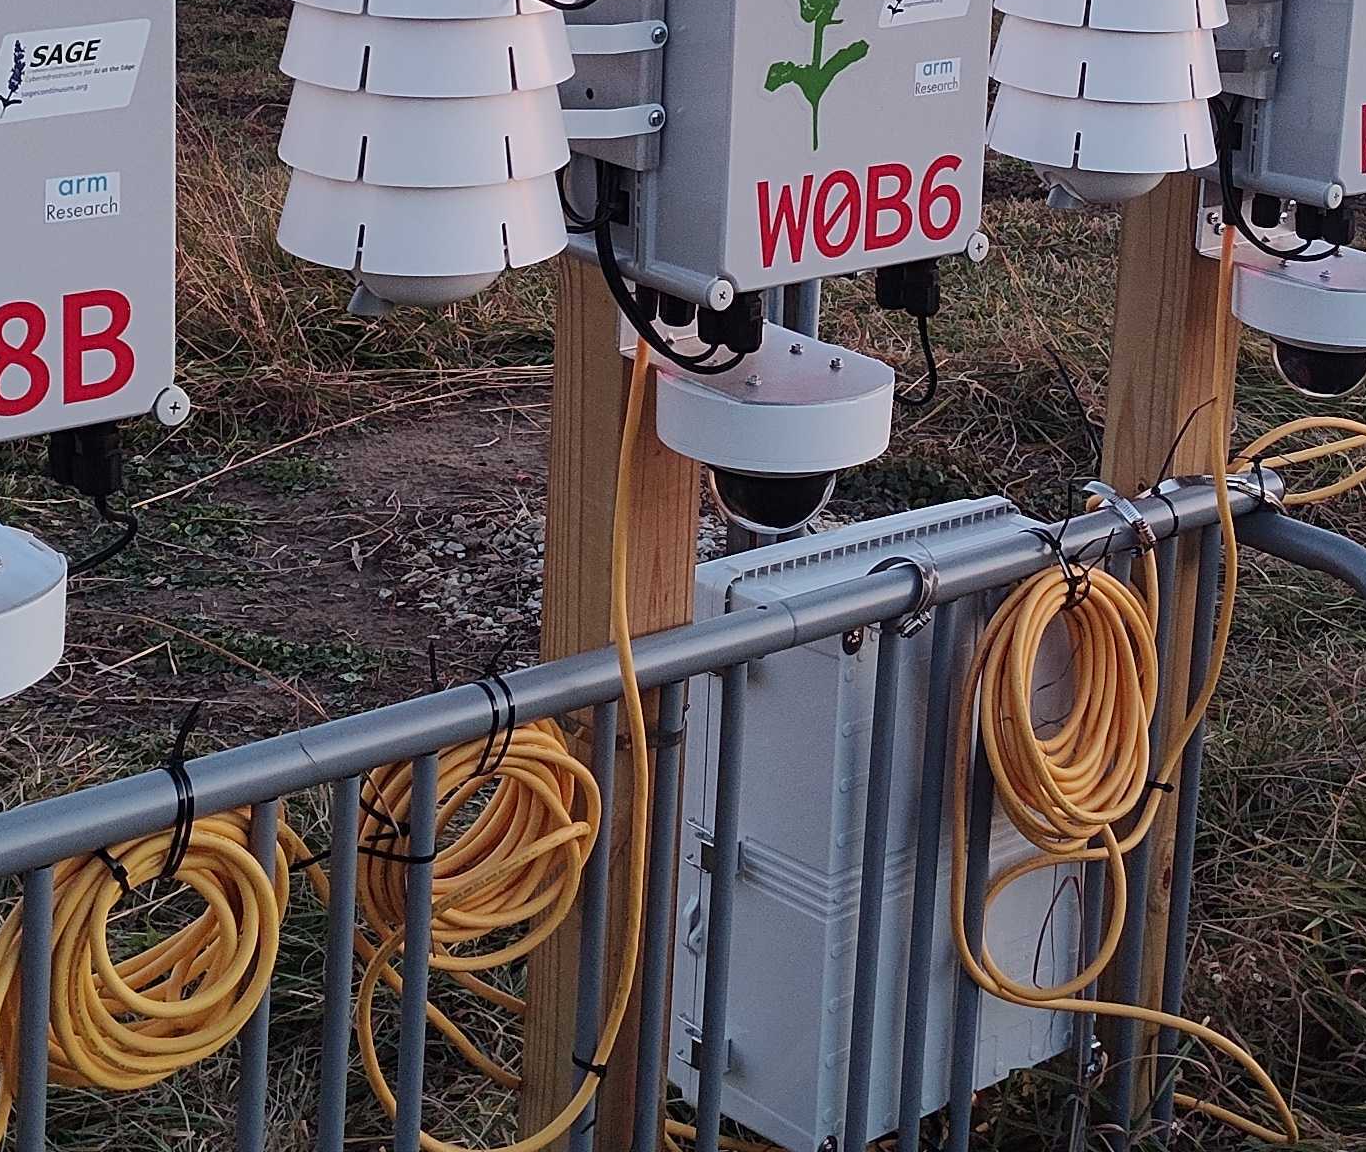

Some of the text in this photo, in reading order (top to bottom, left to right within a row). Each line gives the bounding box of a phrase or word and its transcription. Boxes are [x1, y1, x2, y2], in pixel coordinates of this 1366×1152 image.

[29, 38, 101, 68] SAGE
[923, 60, 952, 76] arm
[915, 77, 959, 95] Research
[59, 176, 107, 196] arm
[46, 195, 118, 221] Research
[756, 154, 962, 268] W0B6
